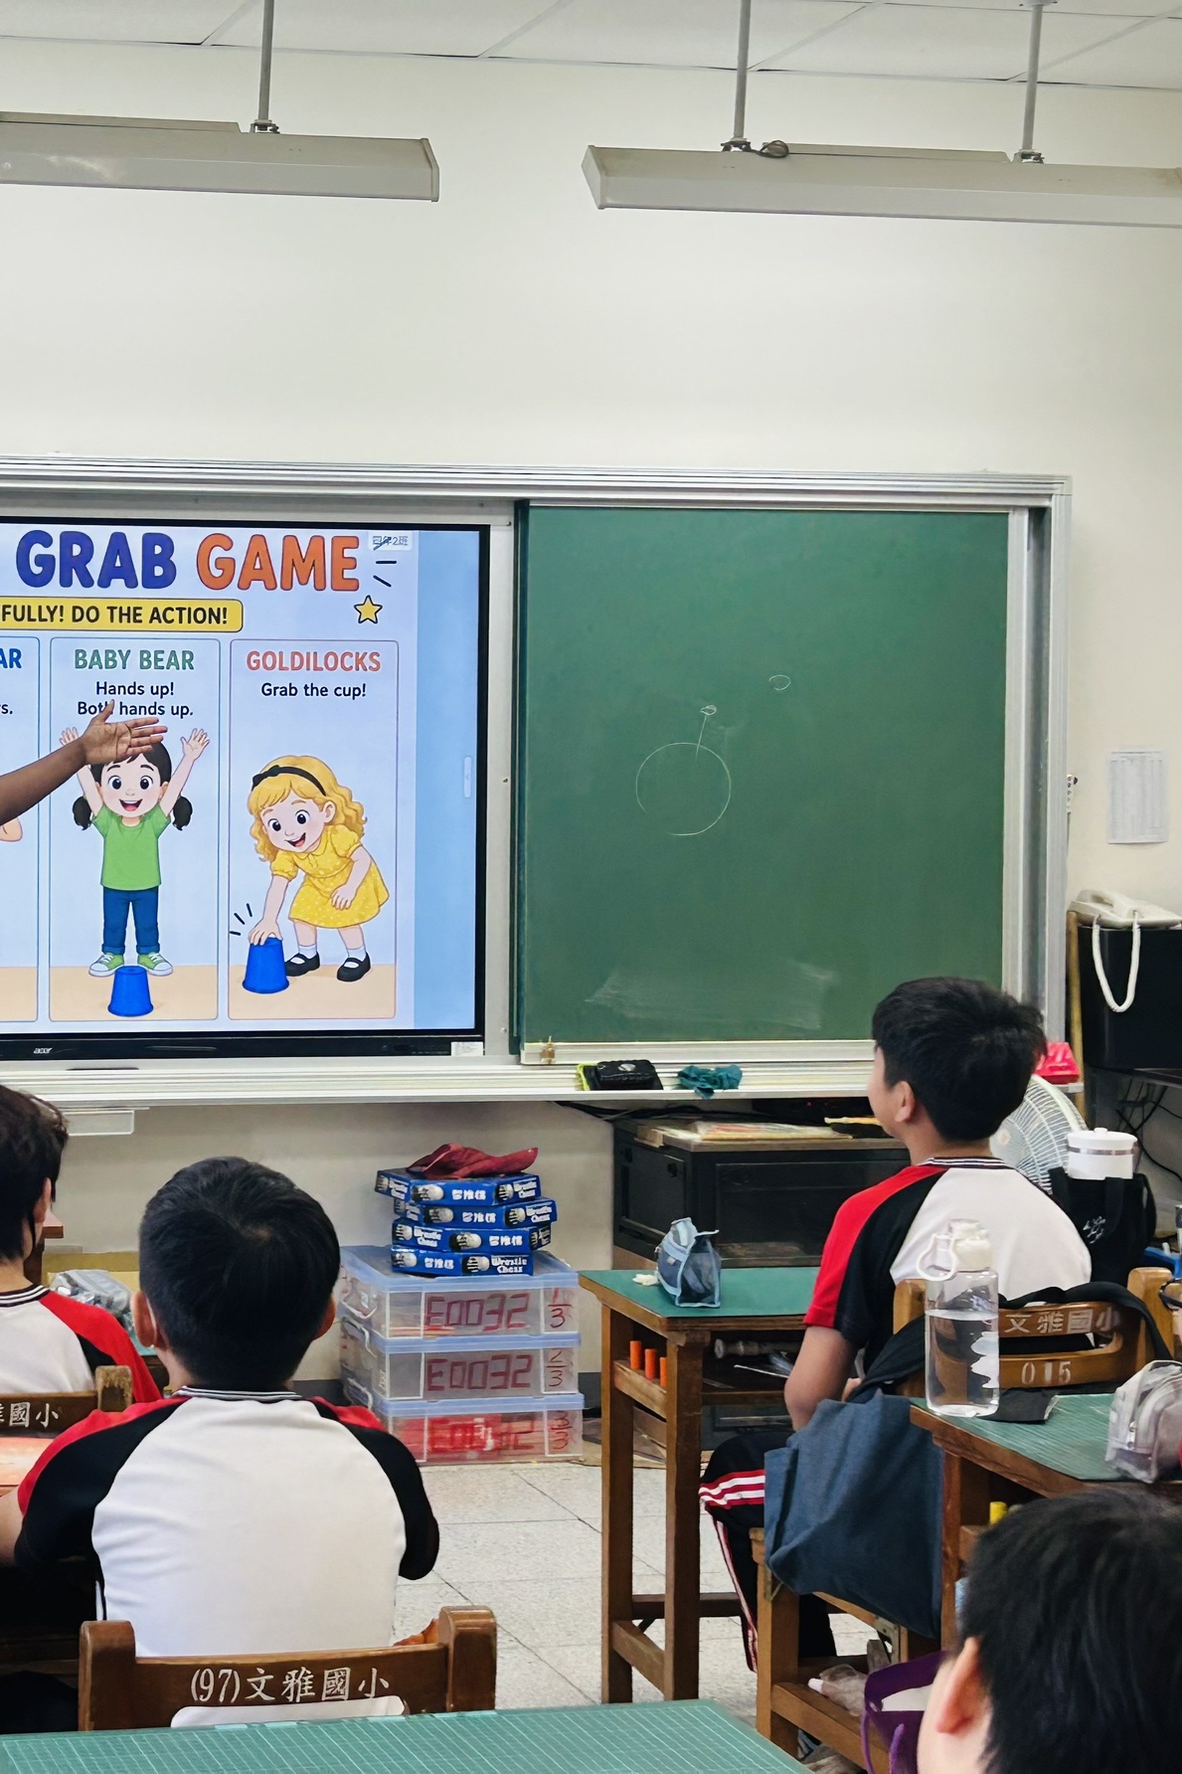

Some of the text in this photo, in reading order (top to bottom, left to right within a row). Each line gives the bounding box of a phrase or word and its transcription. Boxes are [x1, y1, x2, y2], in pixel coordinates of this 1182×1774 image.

[16, 530, 177, 589] GRAB
[196, 533, 360, 592] GAME
[71, 605, 100, 623] DO
[107, 606, 143, 624] THE
[148, 607, 228, 625] ACTION!
[74, 649, 195, 670] BABY BEAR
[246, 650, 381, 672] GOLDILOCKS
[96, 681, 175, 699] Hands up!
[261, 682, 366, 700] Grab the cup!
[119, 701, 165, 716] hands
[171, 705, 194, 719] up.
[190, 1666, 390, 1704] (97)文雅國小
